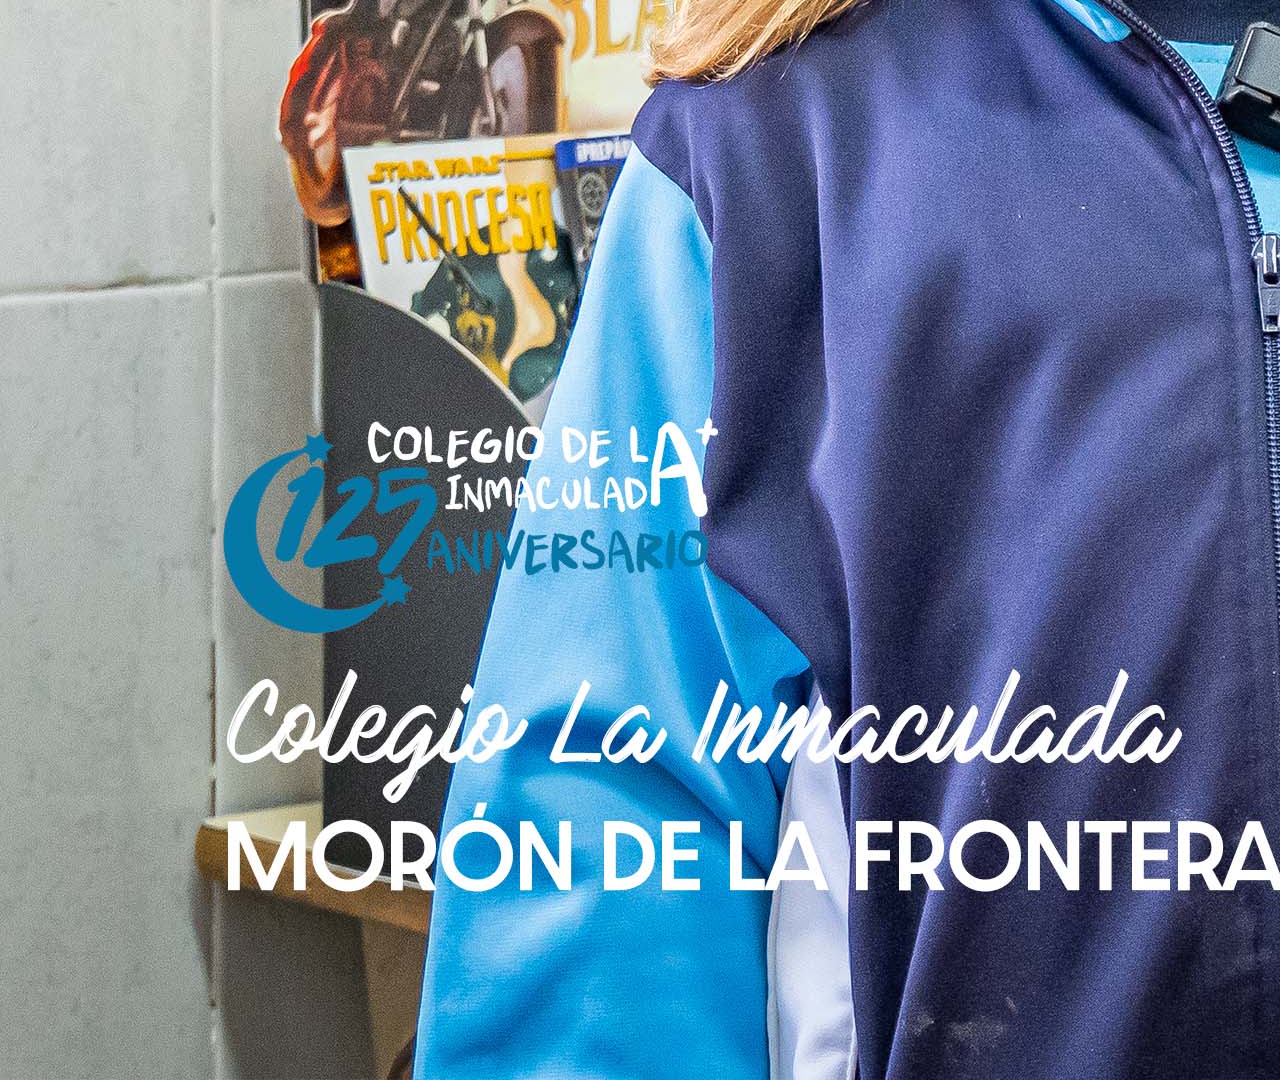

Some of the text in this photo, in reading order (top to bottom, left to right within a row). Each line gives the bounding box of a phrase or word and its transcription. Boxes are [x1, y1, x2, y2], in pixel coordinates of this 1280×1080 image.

[367, 154, 502, 184] STAR WARS
[369, 181, 558, 265] PRINCESA
